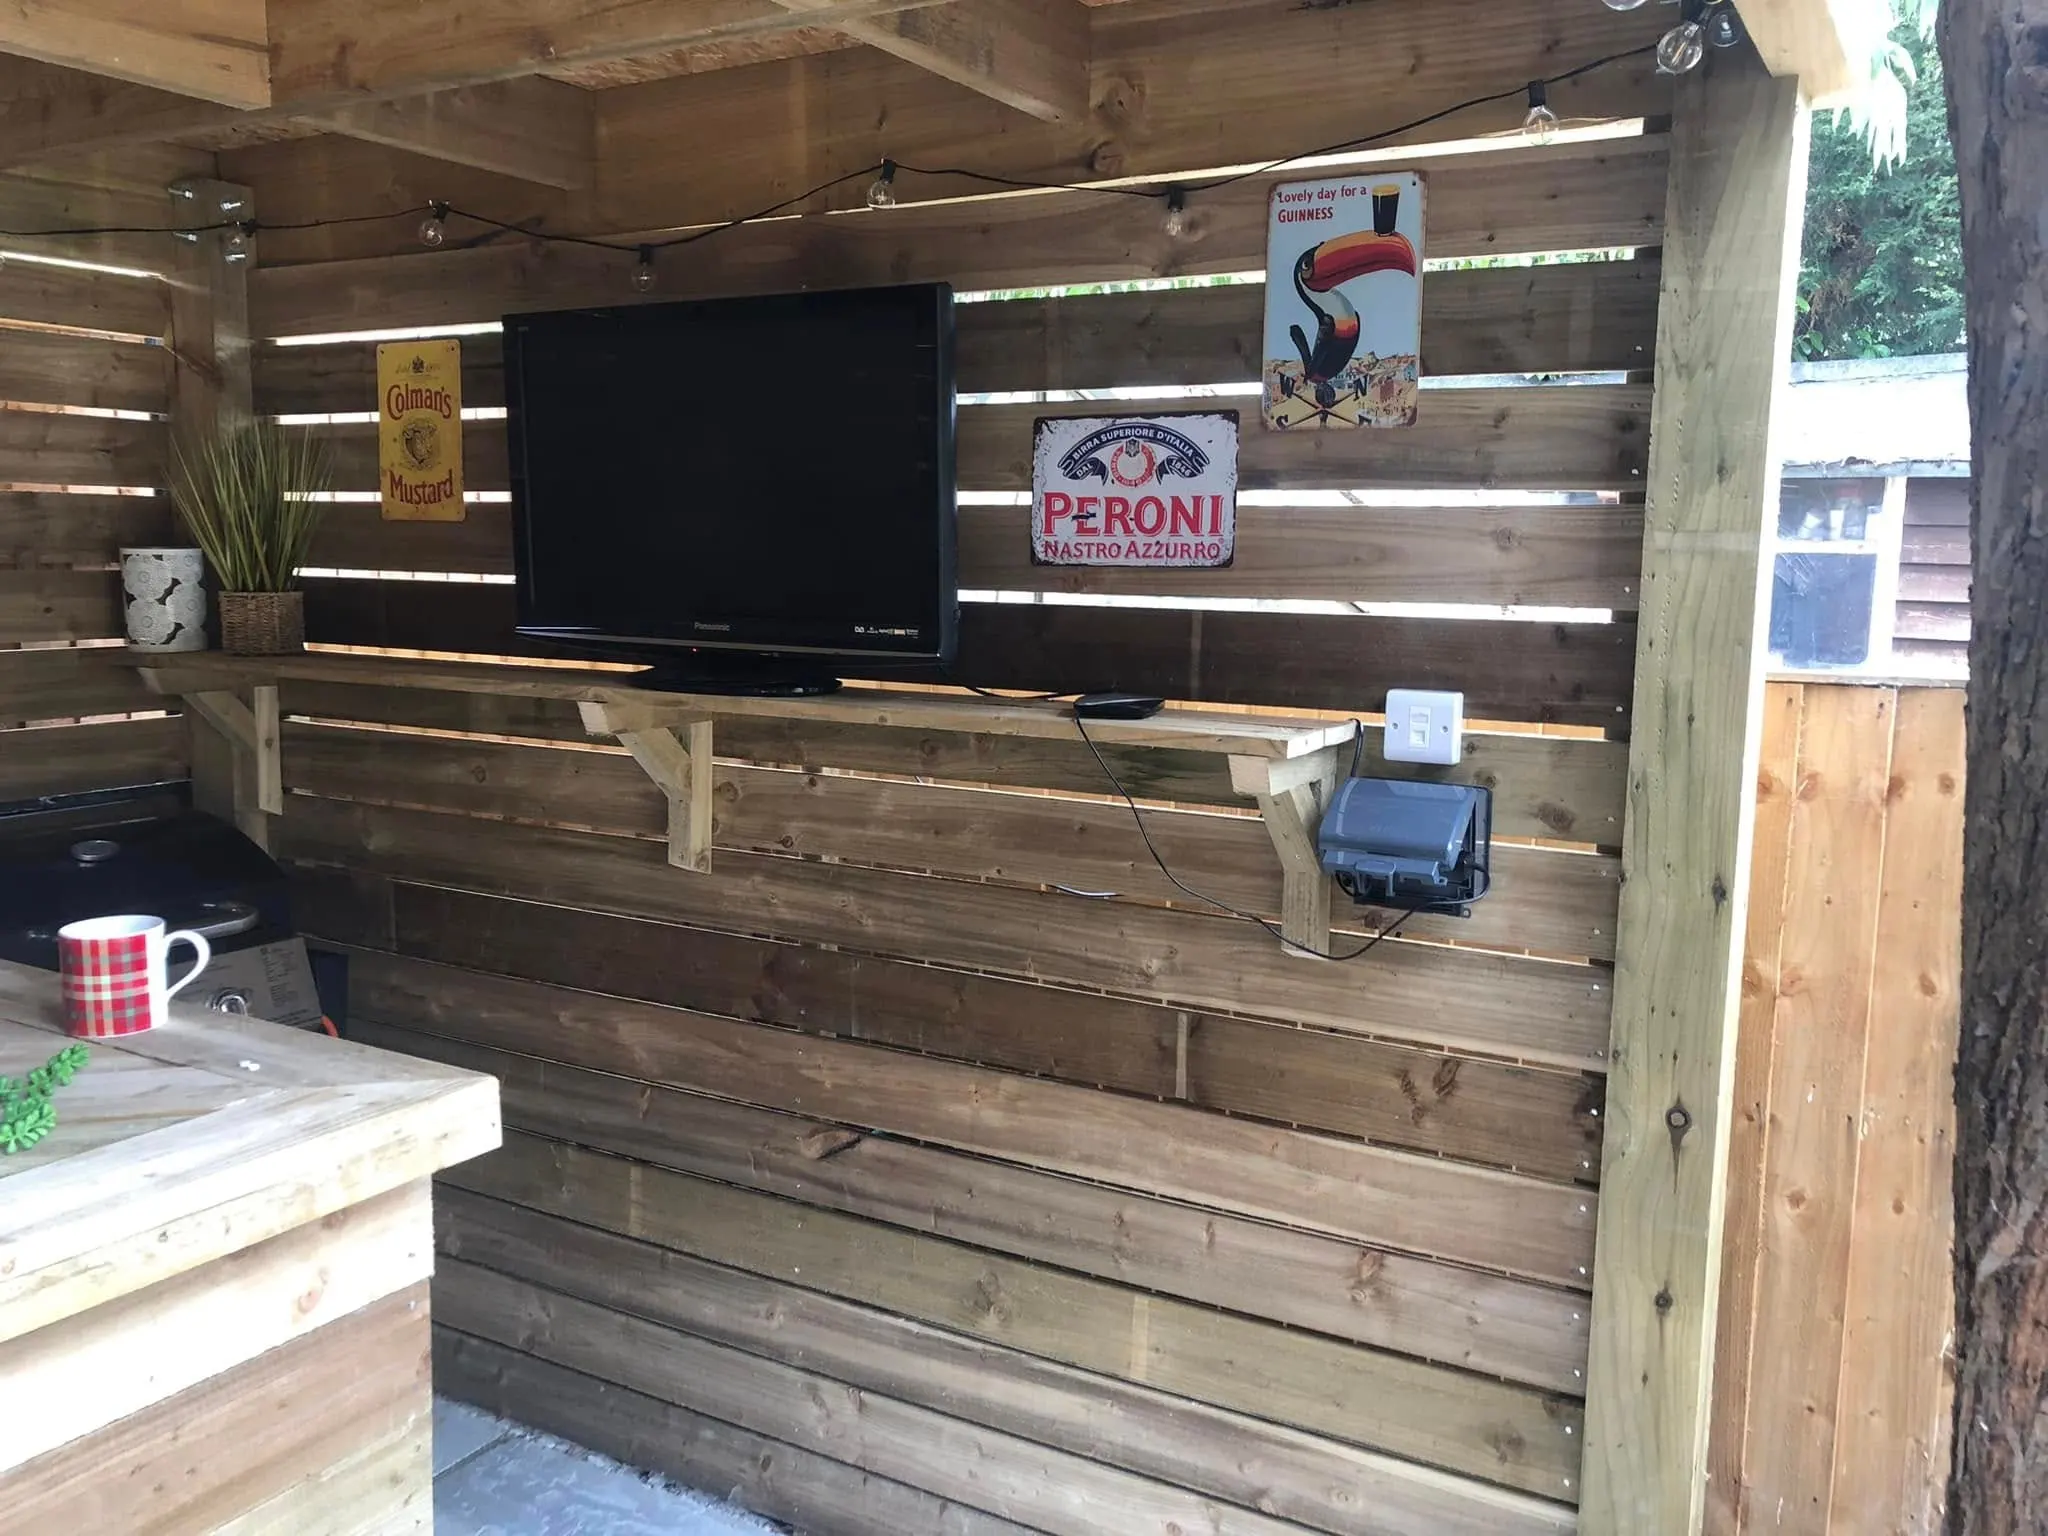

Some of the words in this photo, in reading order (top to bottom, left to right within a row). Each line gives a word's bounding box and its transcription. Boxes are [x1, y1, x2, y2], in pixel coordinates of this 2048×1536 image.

[1277, 188, 1314, 204] Lovely
[1317, 186, 1338, 201] day
[1340, 184, 1357, 198] for
[1359, 185, 1367, 196] a
[1278, 207, 1333, 223] GUINNESS
[387, 383, 452, 421] Colman's
[1072, 437, 1100, 460] BIRRA
[1100, 427, 1155, 443] SUPERIORE
[1156, 431, 1194, 458] D'ITALIA
[1076, 462, 1093, 478] DAL
[1170, 459, 1193, 478] 1846
[388, 468, 454, 506] Mustard
[1042, 491, 1225, 537] PERONI
[1044, 540, 1120, 558] NASTRO
[1125, 539, 1221, 560] AZZURRO
